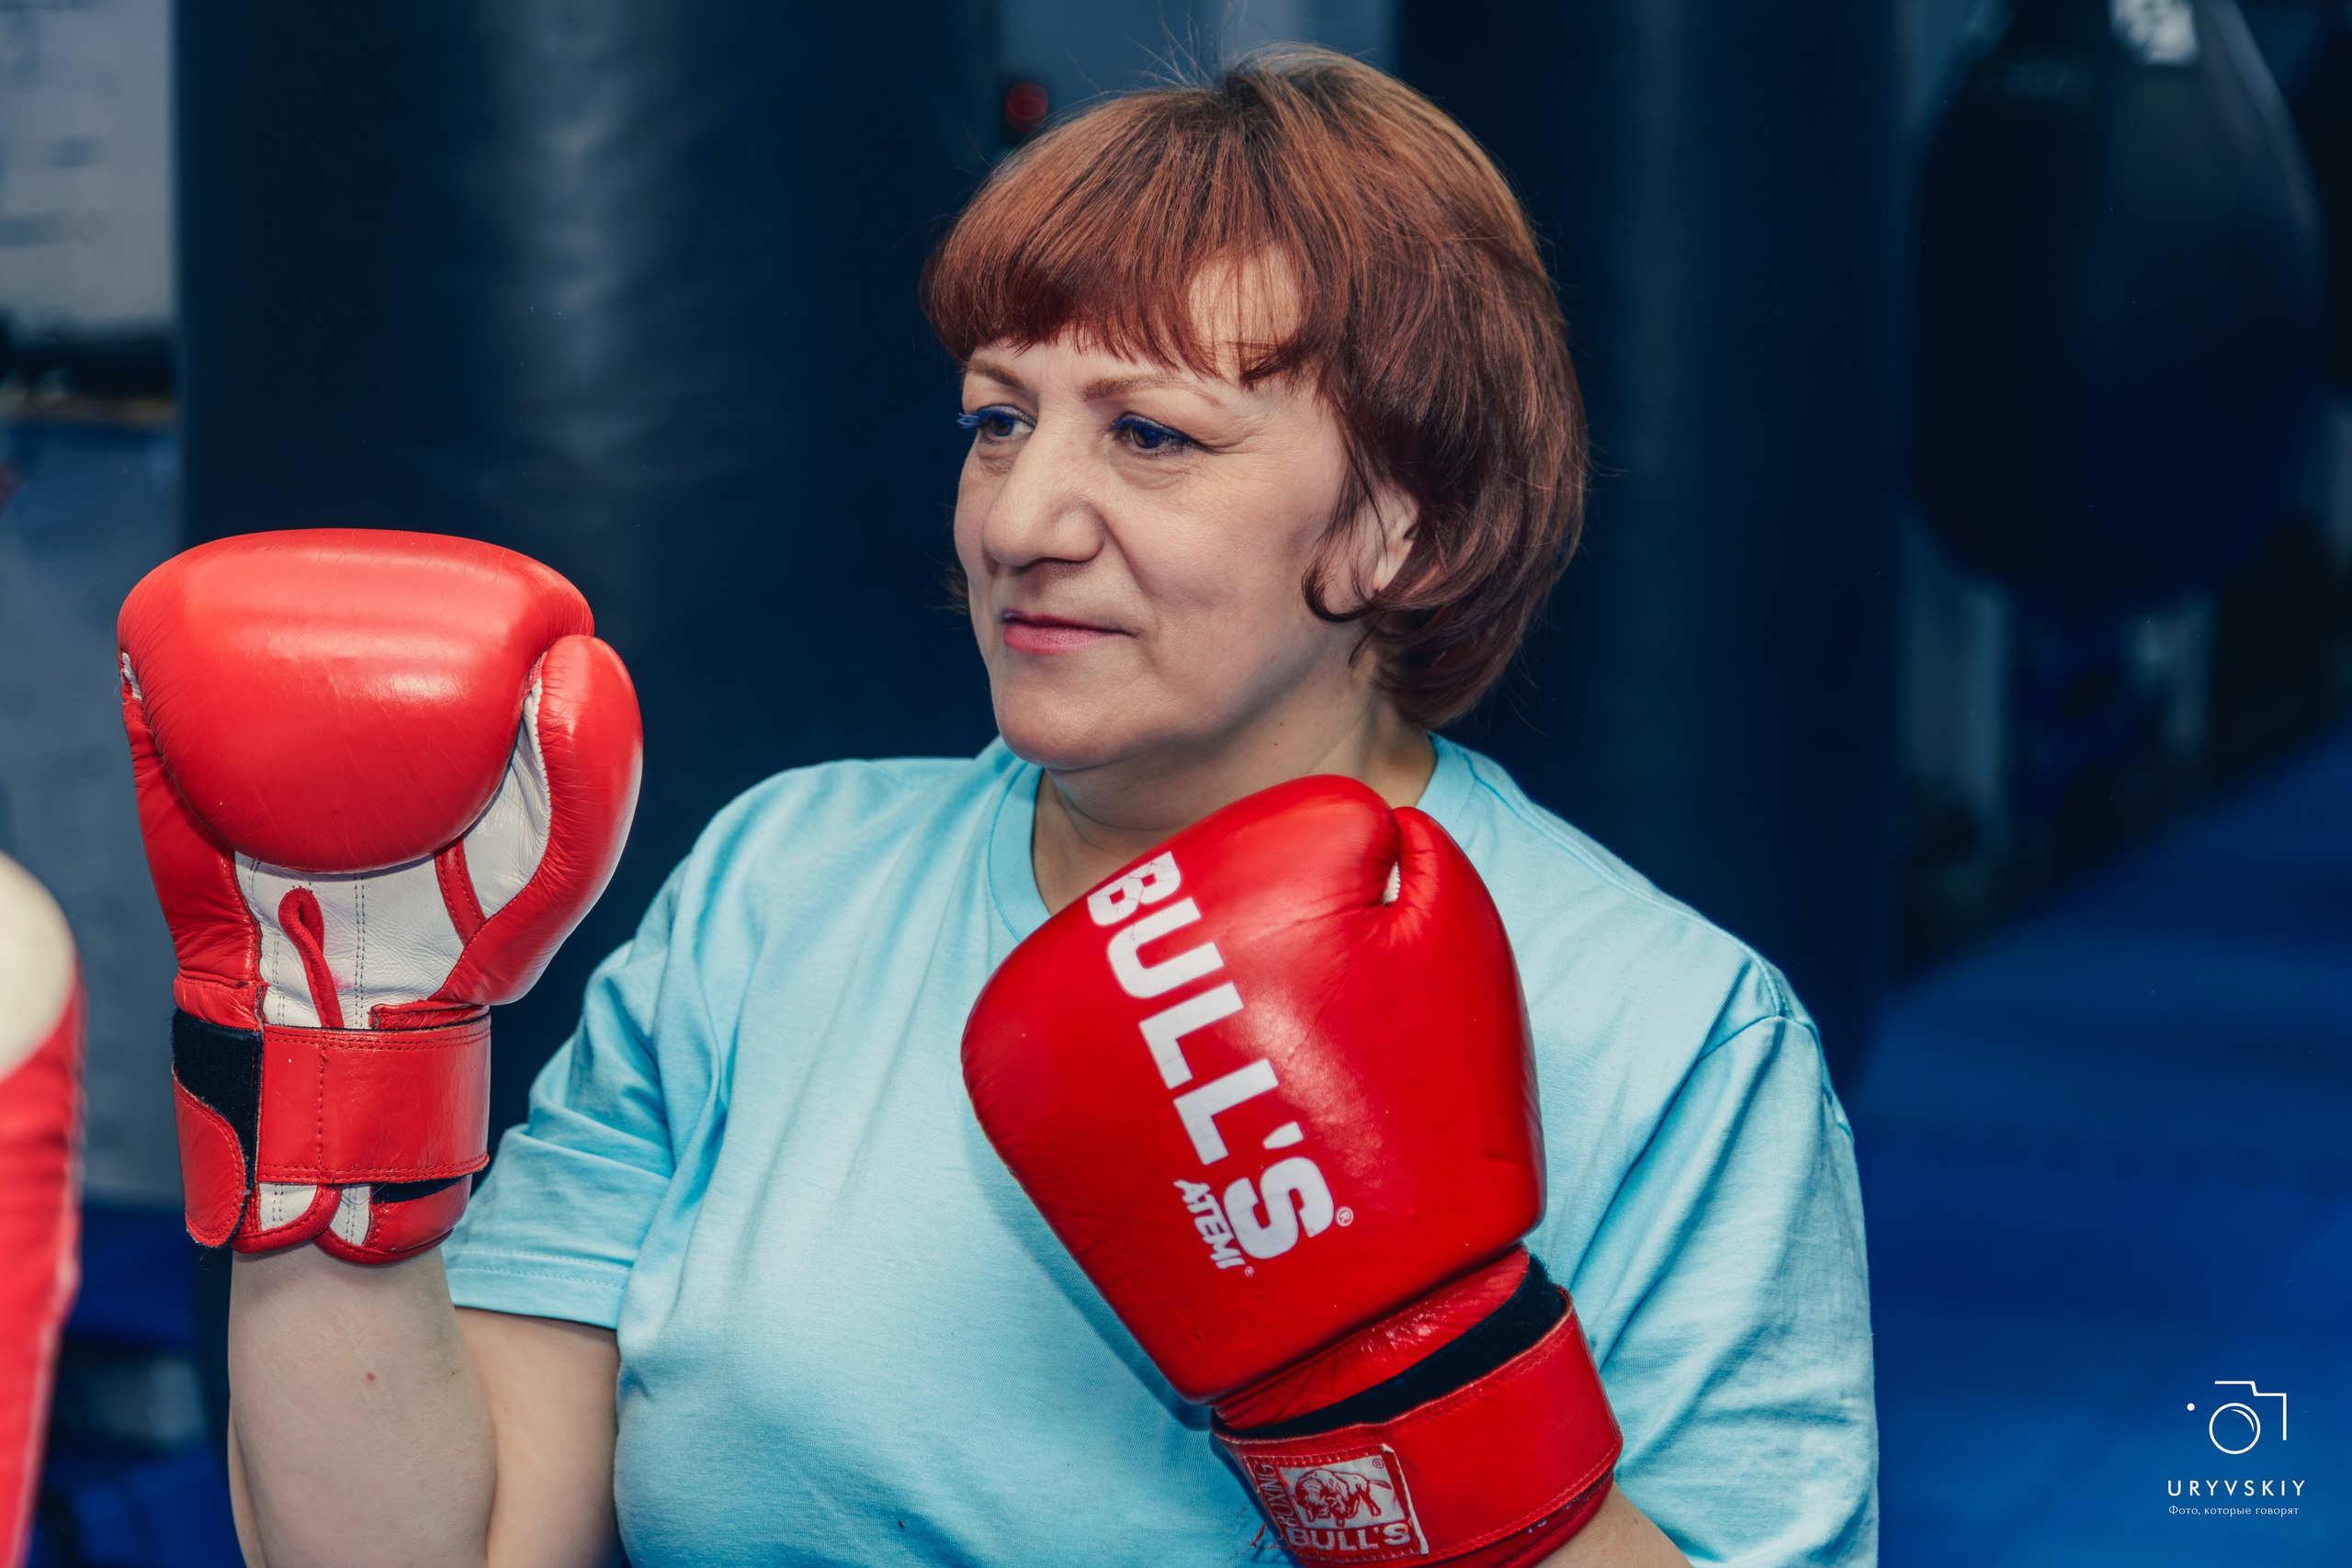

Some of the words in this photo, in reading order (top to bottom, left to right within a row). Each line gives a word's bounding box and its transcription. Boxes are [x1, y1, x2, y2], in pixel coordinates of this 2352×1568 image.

[1087, 852, 1334, 1259] BULL'S
[1173, 1179, 1246, 1269] ATEMI
[1256, 1464, 1300, 1528] BOXING
[1286, 1523, 1411, 1551] BULL'S
